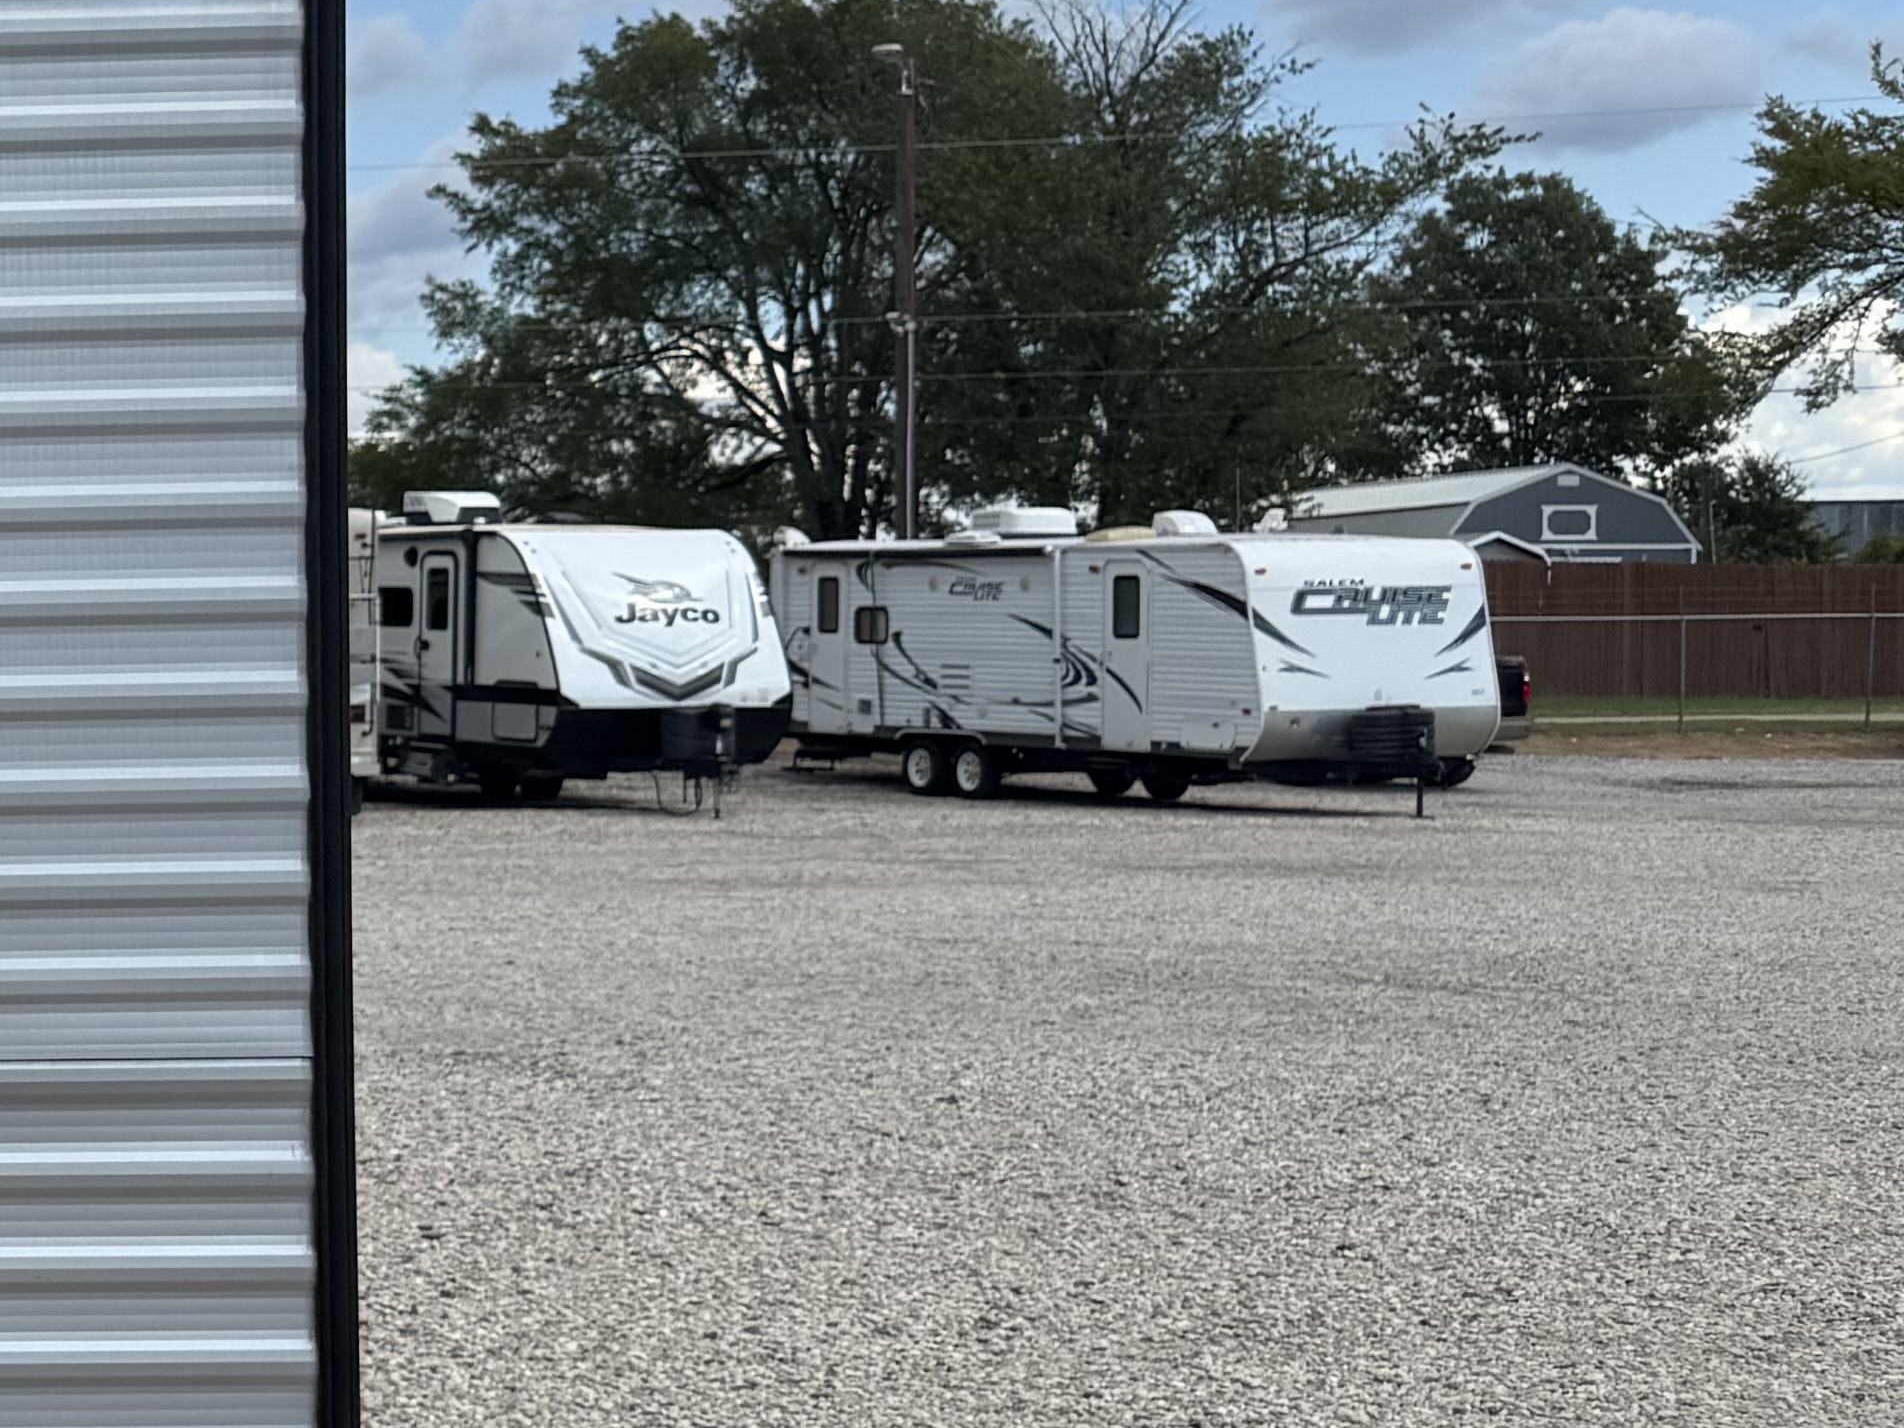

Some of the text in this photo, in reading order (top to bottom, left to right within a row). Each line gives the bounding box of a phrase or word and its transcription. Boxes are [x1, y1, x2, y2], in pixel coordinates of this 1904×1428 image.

[1290, 584, 1452, 615] CRUISE
[614, 602, 720, 627] Jayco
[1366, 605, 1449, 626] LITE
